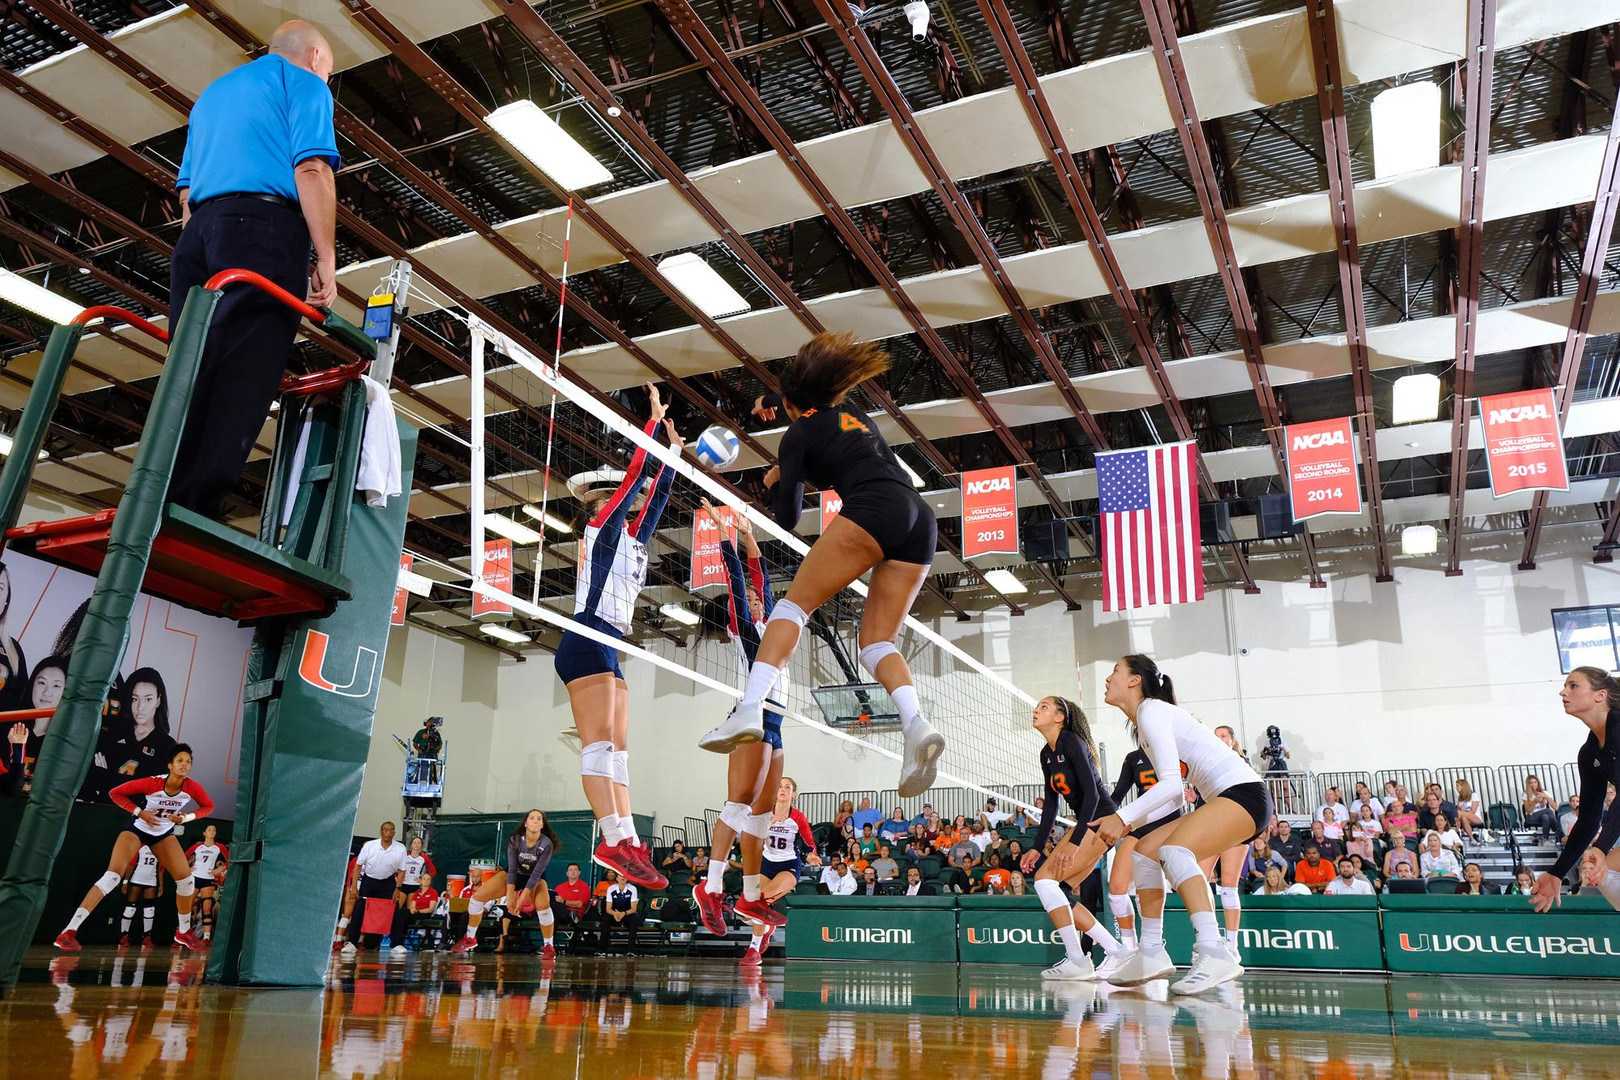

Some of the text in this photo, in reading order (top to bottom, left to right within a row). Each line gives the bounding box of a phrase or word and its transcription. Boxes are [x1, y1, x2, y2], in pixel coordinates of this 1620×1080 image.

[1489, 404, 1549, 425] NCAA
[839, 412, 870, 433] 4
[1293, 430, 1345, 450] NCAA
[1499, 436, 1546, 447] VOLLEYBALL
[1294, 467, 1350, 480] SECOND ROUND
[1300, 462, 1343, 472] VOLLEYBALL
[1508, 463, 1547, 477] 2015
[966, 478, 1010, 495] NCAA
[1307, 488, 1343, 501] 2014
[826, 500, 843, 513] NC
[971, 506, 1007, 515] VOLLEYBALL
[698, 515, 733, 532] NCA
[977, 530, 1005, 542] 2013
[703, 565, 724, 575] 2011
[298, 628, 378, 697] U
[1140, 769, 1157, 790] 5
[769, 835, 787, 850] 16
[144, 857, 155, 866] 12
[203, 855, 209, 863] 7
[410, 866, 416, 875] 2
